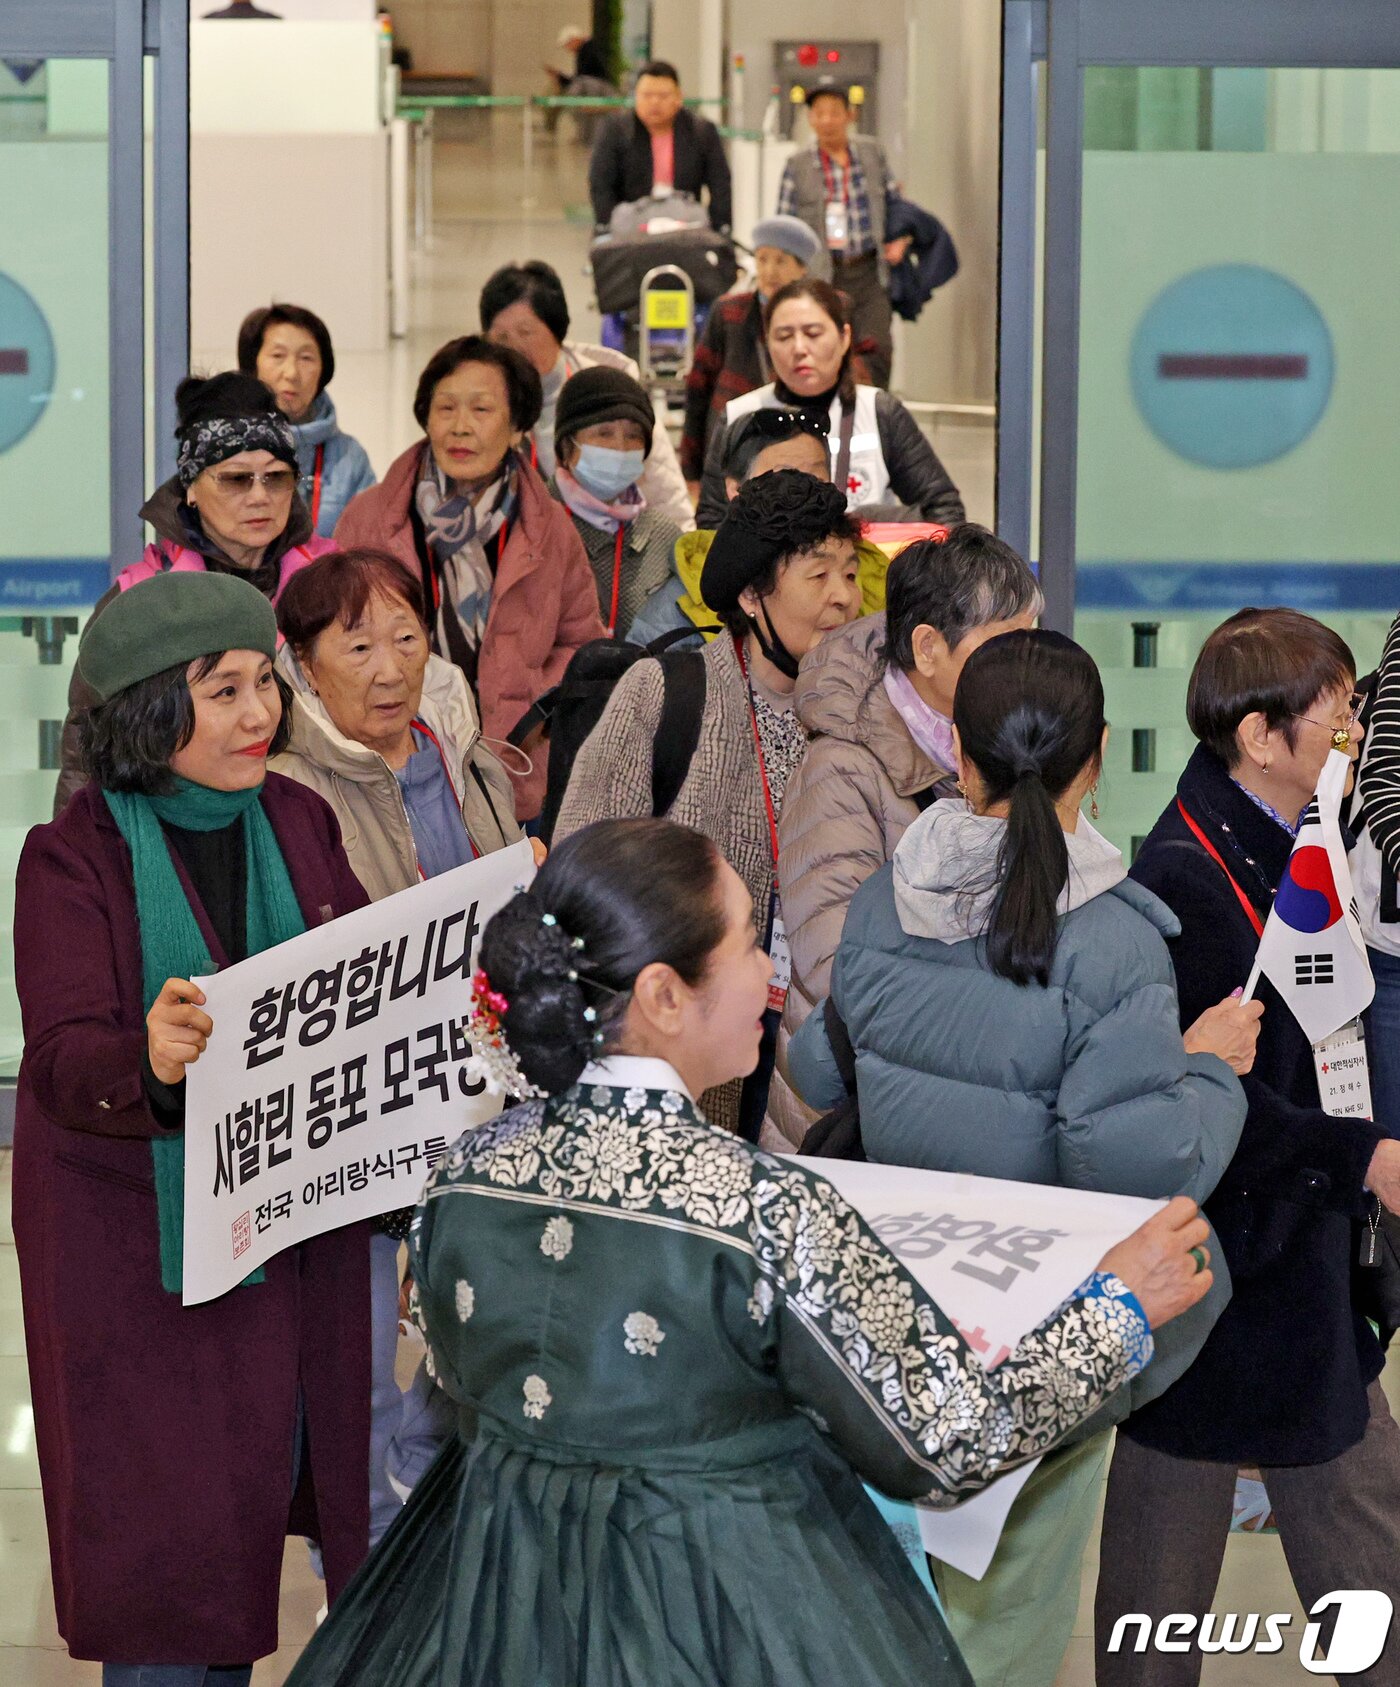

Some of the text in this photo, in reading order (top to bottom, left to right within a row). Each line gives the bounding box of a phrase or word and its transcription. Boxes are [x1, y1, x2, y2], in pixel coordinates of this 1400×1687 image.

[243, 900, 480, 1069] 환영합니다
[1330, 1056, 1364, 1072] 대한적십자사
[1332, 1107, 1343, 1116] TEN
[1357, 1103, 1364, 1111] SU
[212, 1082, 295, 1197] 사할린
[307, 1053, 367, 1149] 동포
[255, 1134, 450, 1234] 전국 아리랑식구들
